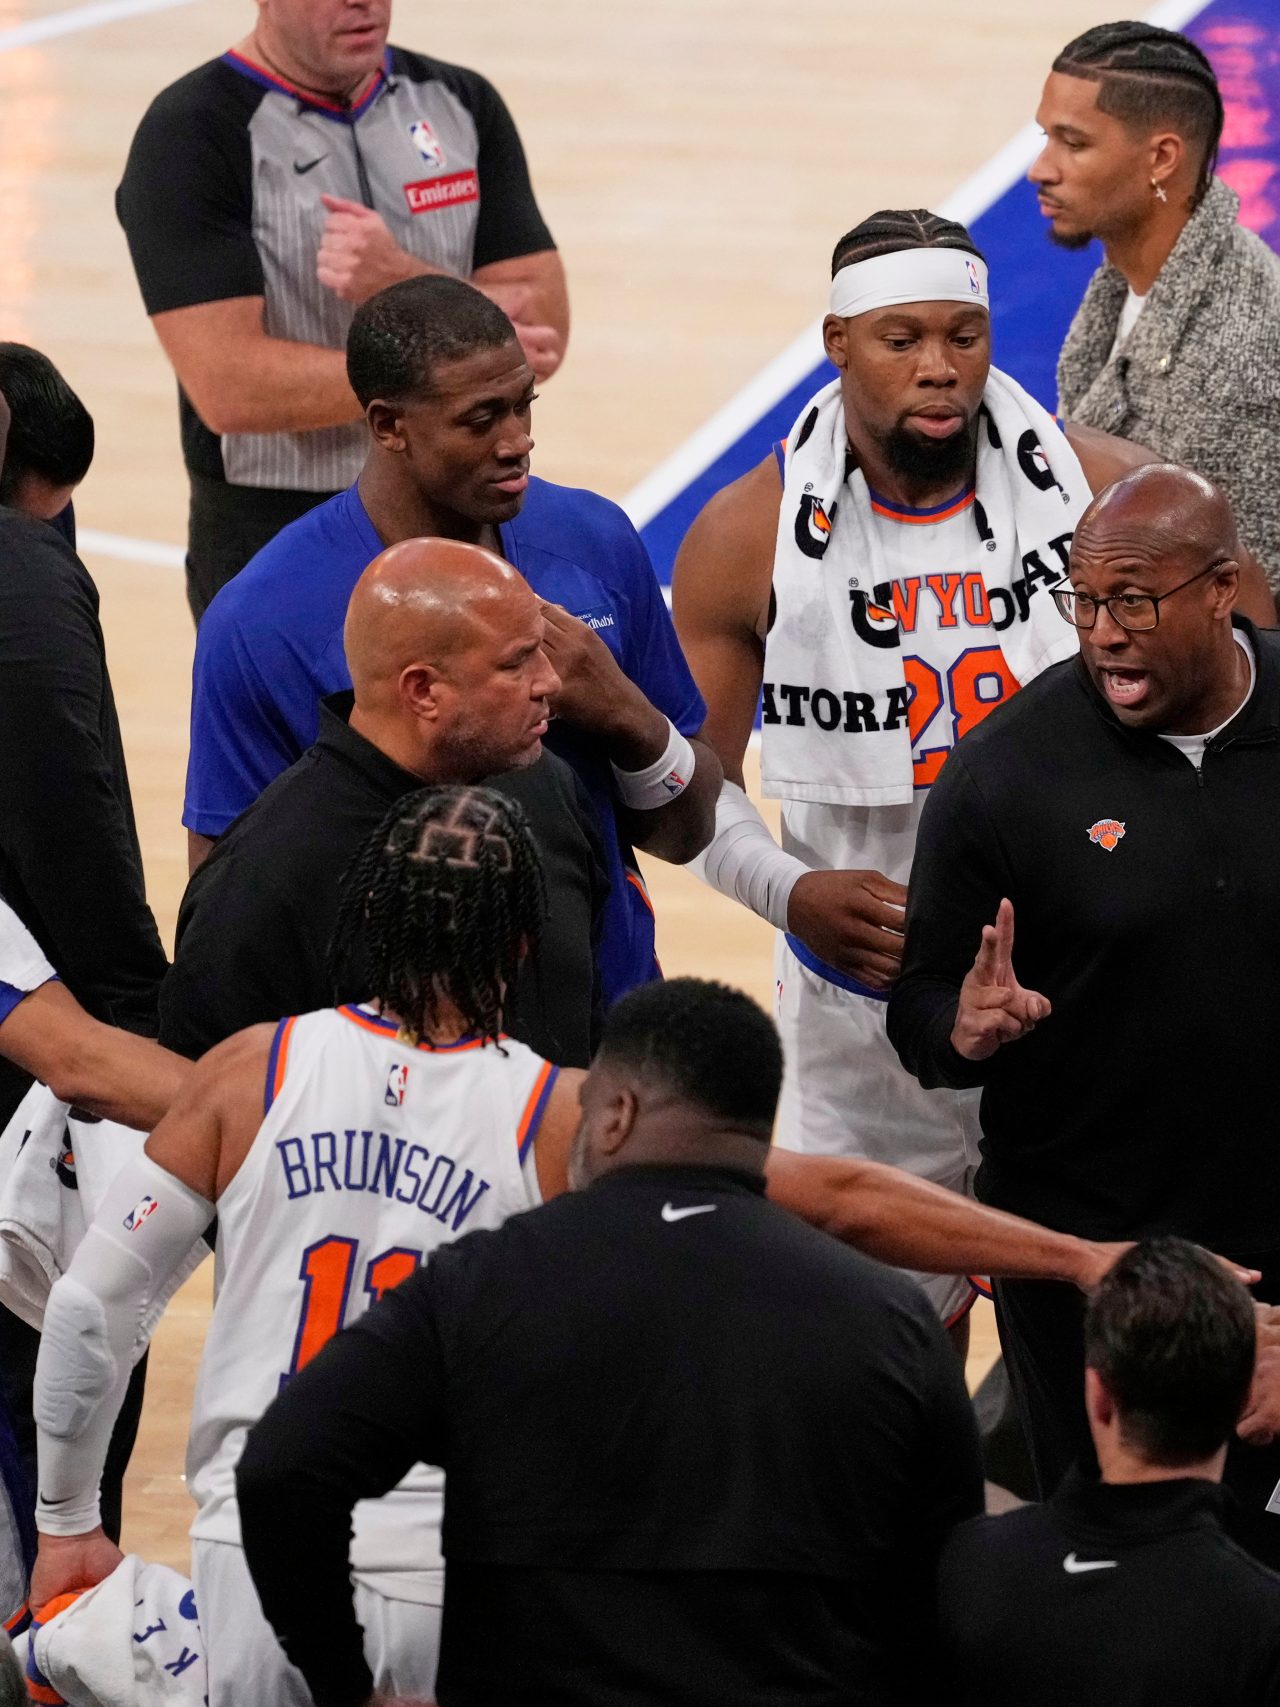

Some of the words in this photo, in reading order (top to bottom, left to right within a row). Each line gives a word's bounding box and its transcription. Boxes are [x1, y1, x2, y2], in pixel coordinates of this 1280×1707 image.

[407, 179, 476, 208] Emirates
[587, 613, 614, 629] dhabi
[276, 1130, 490, 1232] BRUNSON
